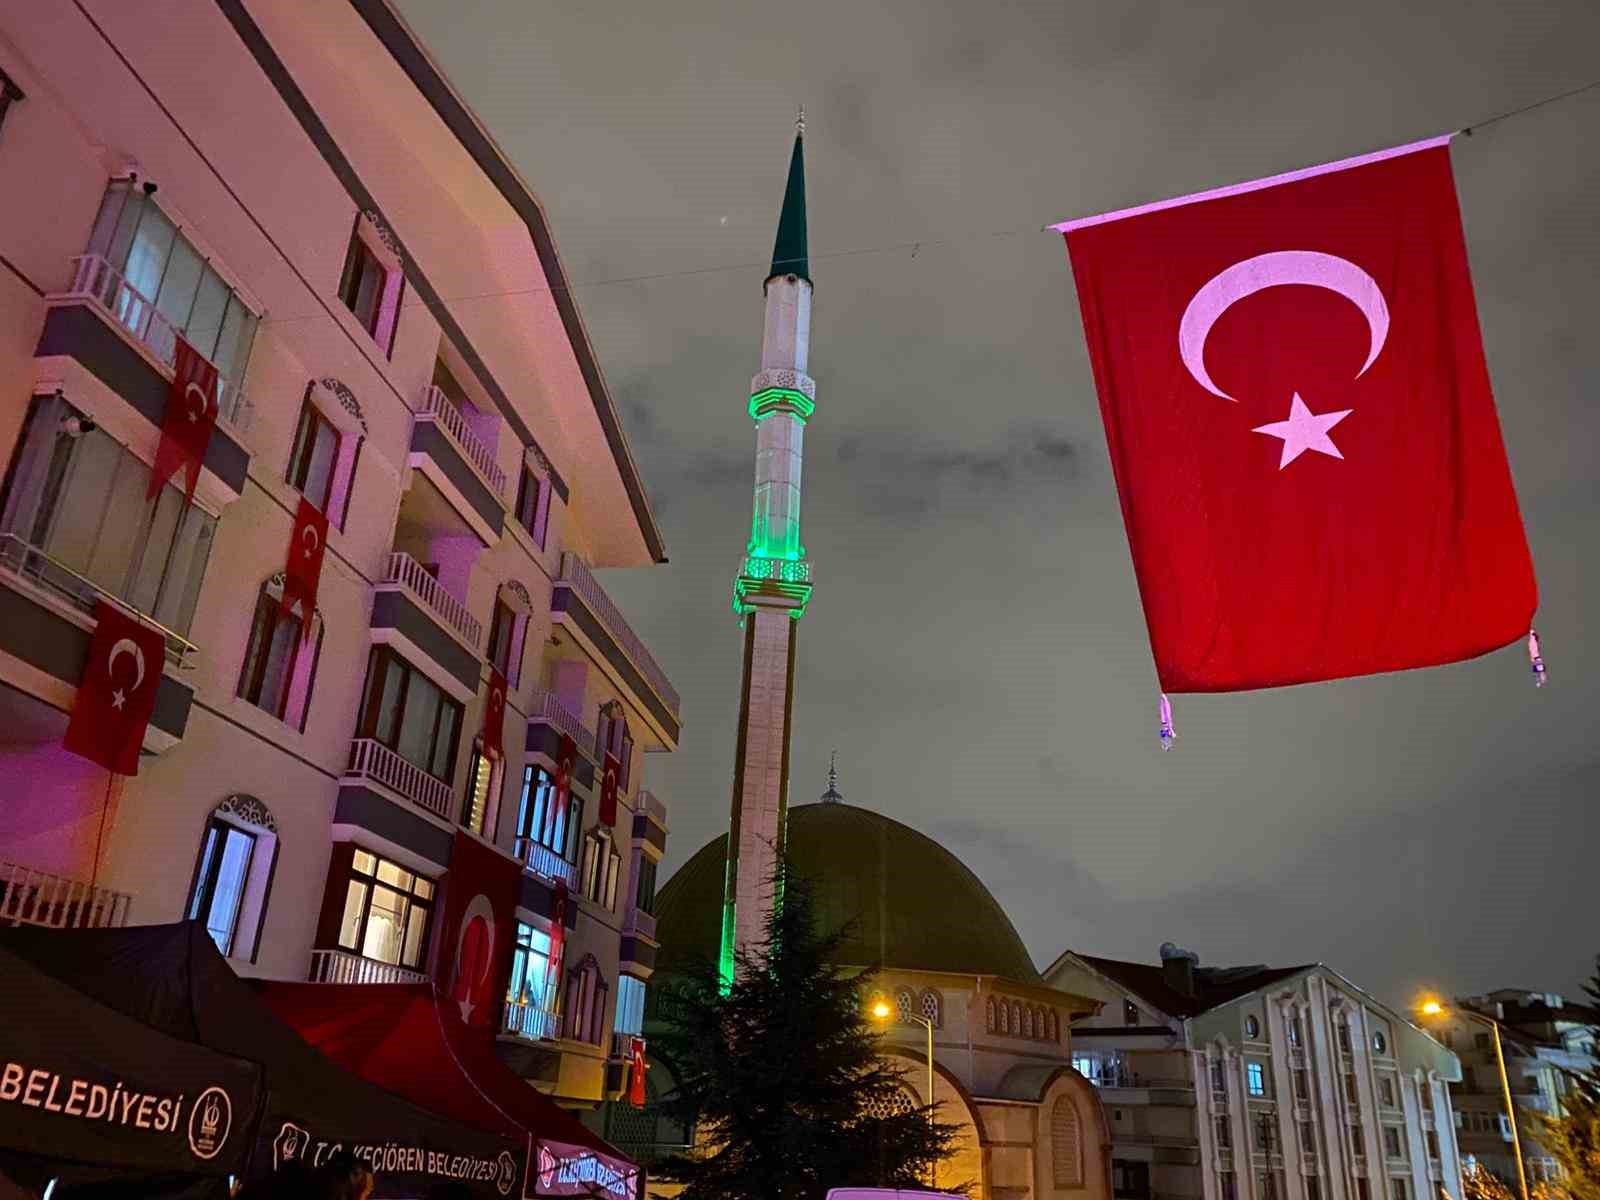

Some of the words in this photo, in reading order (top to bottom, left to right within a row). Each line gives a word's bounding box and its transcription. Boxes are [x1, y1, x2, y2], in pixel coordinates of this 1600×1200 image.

[0, 1063, 183, 1132] BELEDİYESİ
[314, 1142, 343, 1168] T.C
[428, 1151, 498, 1180] BELEDİYESİ
